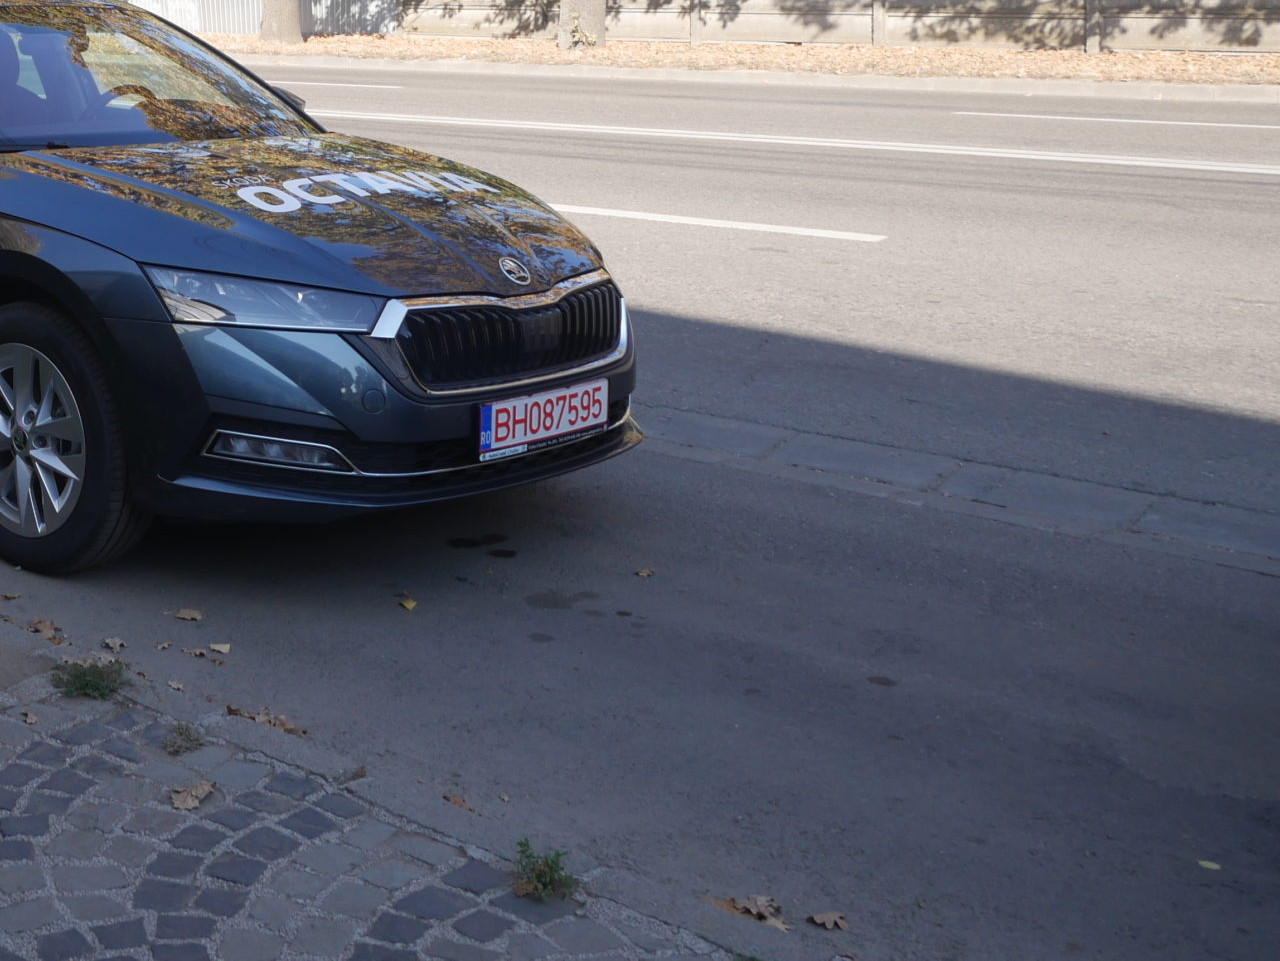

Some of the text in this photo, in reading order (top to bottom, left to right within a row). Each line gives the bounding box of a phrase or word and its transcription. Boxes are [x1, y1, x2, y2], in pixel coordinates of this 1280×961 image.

[237, 171, 500, 213] OCTAVIA
[495, 387, 602, 443] BH087595
[480, 430, 491, 446] RO
